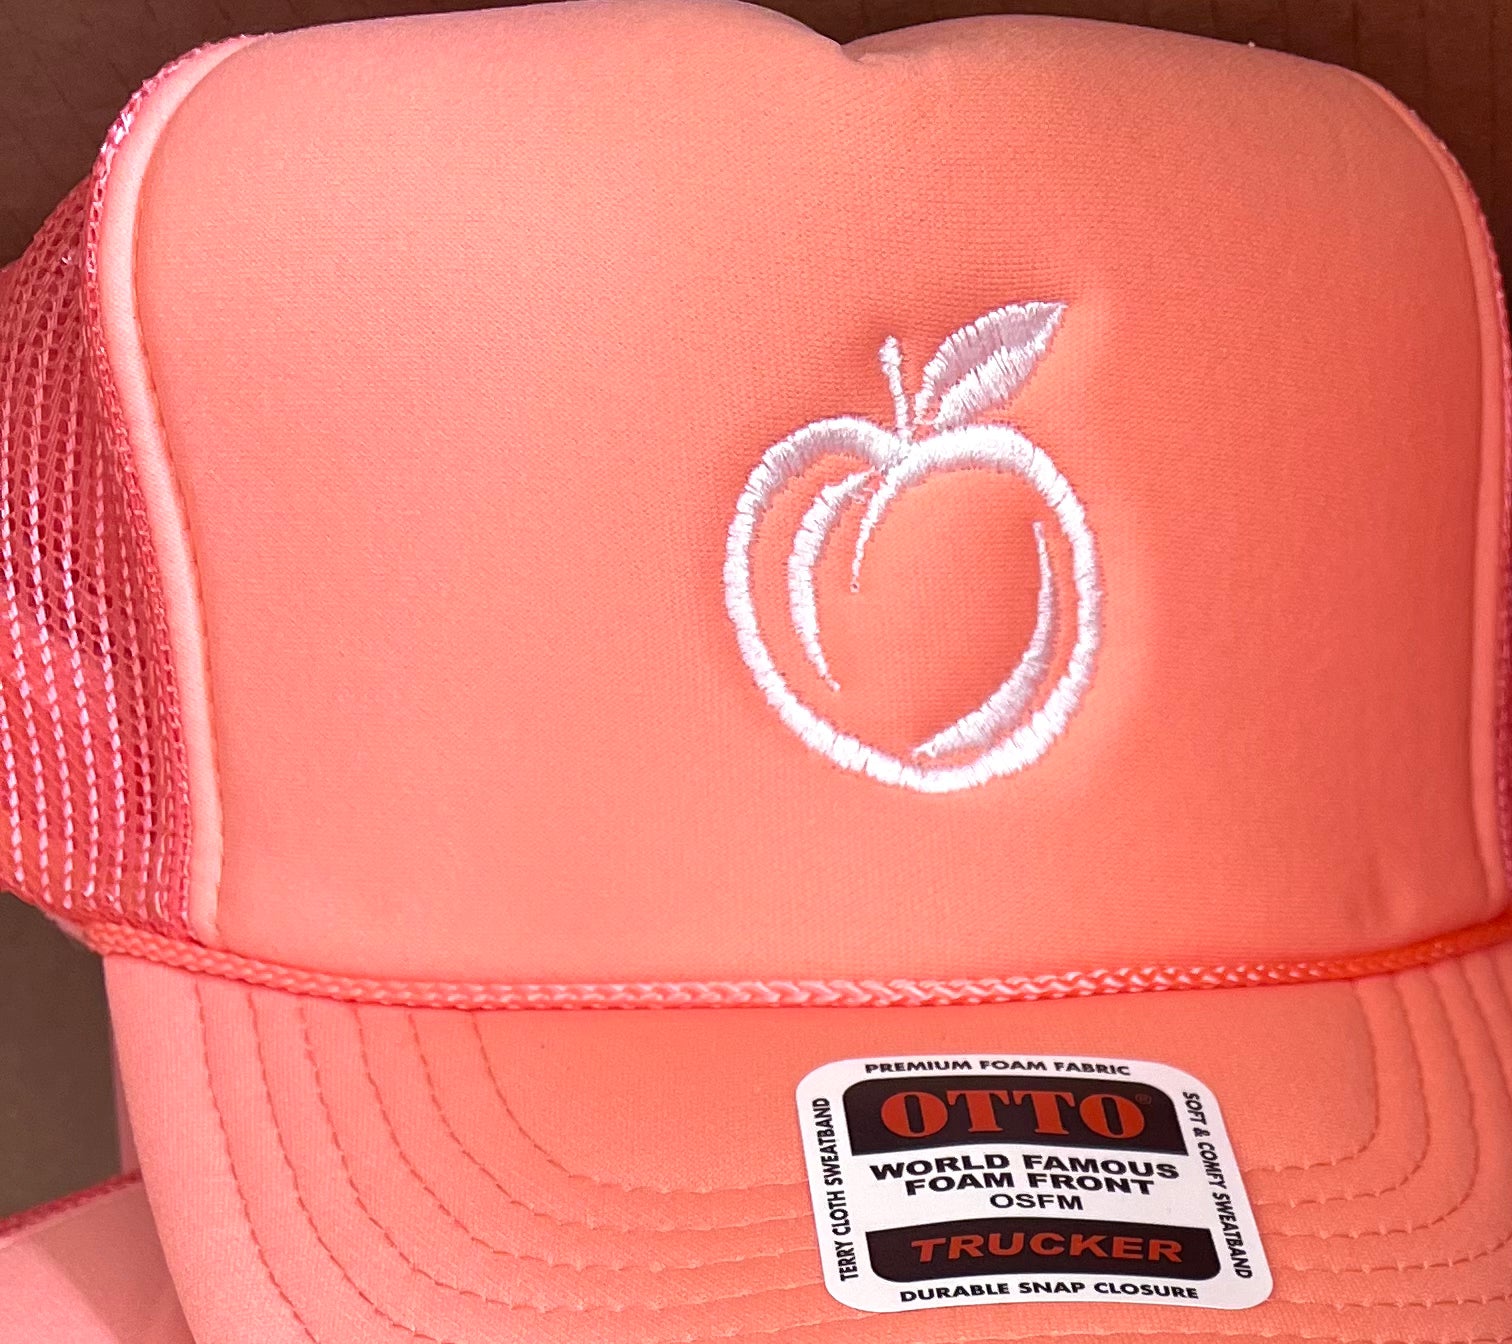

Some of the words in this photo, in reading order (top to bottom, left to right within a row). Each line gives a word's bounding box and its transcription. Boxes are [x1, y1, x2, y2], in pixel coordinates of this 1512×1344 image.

[865, 1060, 973, 1073] PREMIUM
[980, 1060, 1047, 1071] FOAM
[1055, 1062, 1131, 1076] FABRIC
[1182, 1091, 1207, 1125] SOFT
[812, 1097, 843, 1186] SWEATBAND
[1192, 1127, 1210, 1138] &
[870, 1154, 1010, 1180] WORLD
[1024, 1154, 1180, 1179] FAMOUS
[1198, 1141, 1227, 1189] COMFY
[906, 1173, 1015, 1195] FOAM
[1027, 1174, 1155, 1195] FRONT
[826, 1190, 851, 1236] CLOTH
[989, 1195, 1084, 1211] OSFM
[911, 1233, 1182, 1263] TRUCKER
[1212, 1192, 1253, 1279] SWEATBAND
[834, 1240, 859, 1282] TERRY
[900, 1282, 1011, 1302] DURABLE
[1019, 1281, 1085, 1294] SNAP
[1094, 1282, 1199, 1299] CLOSURE
